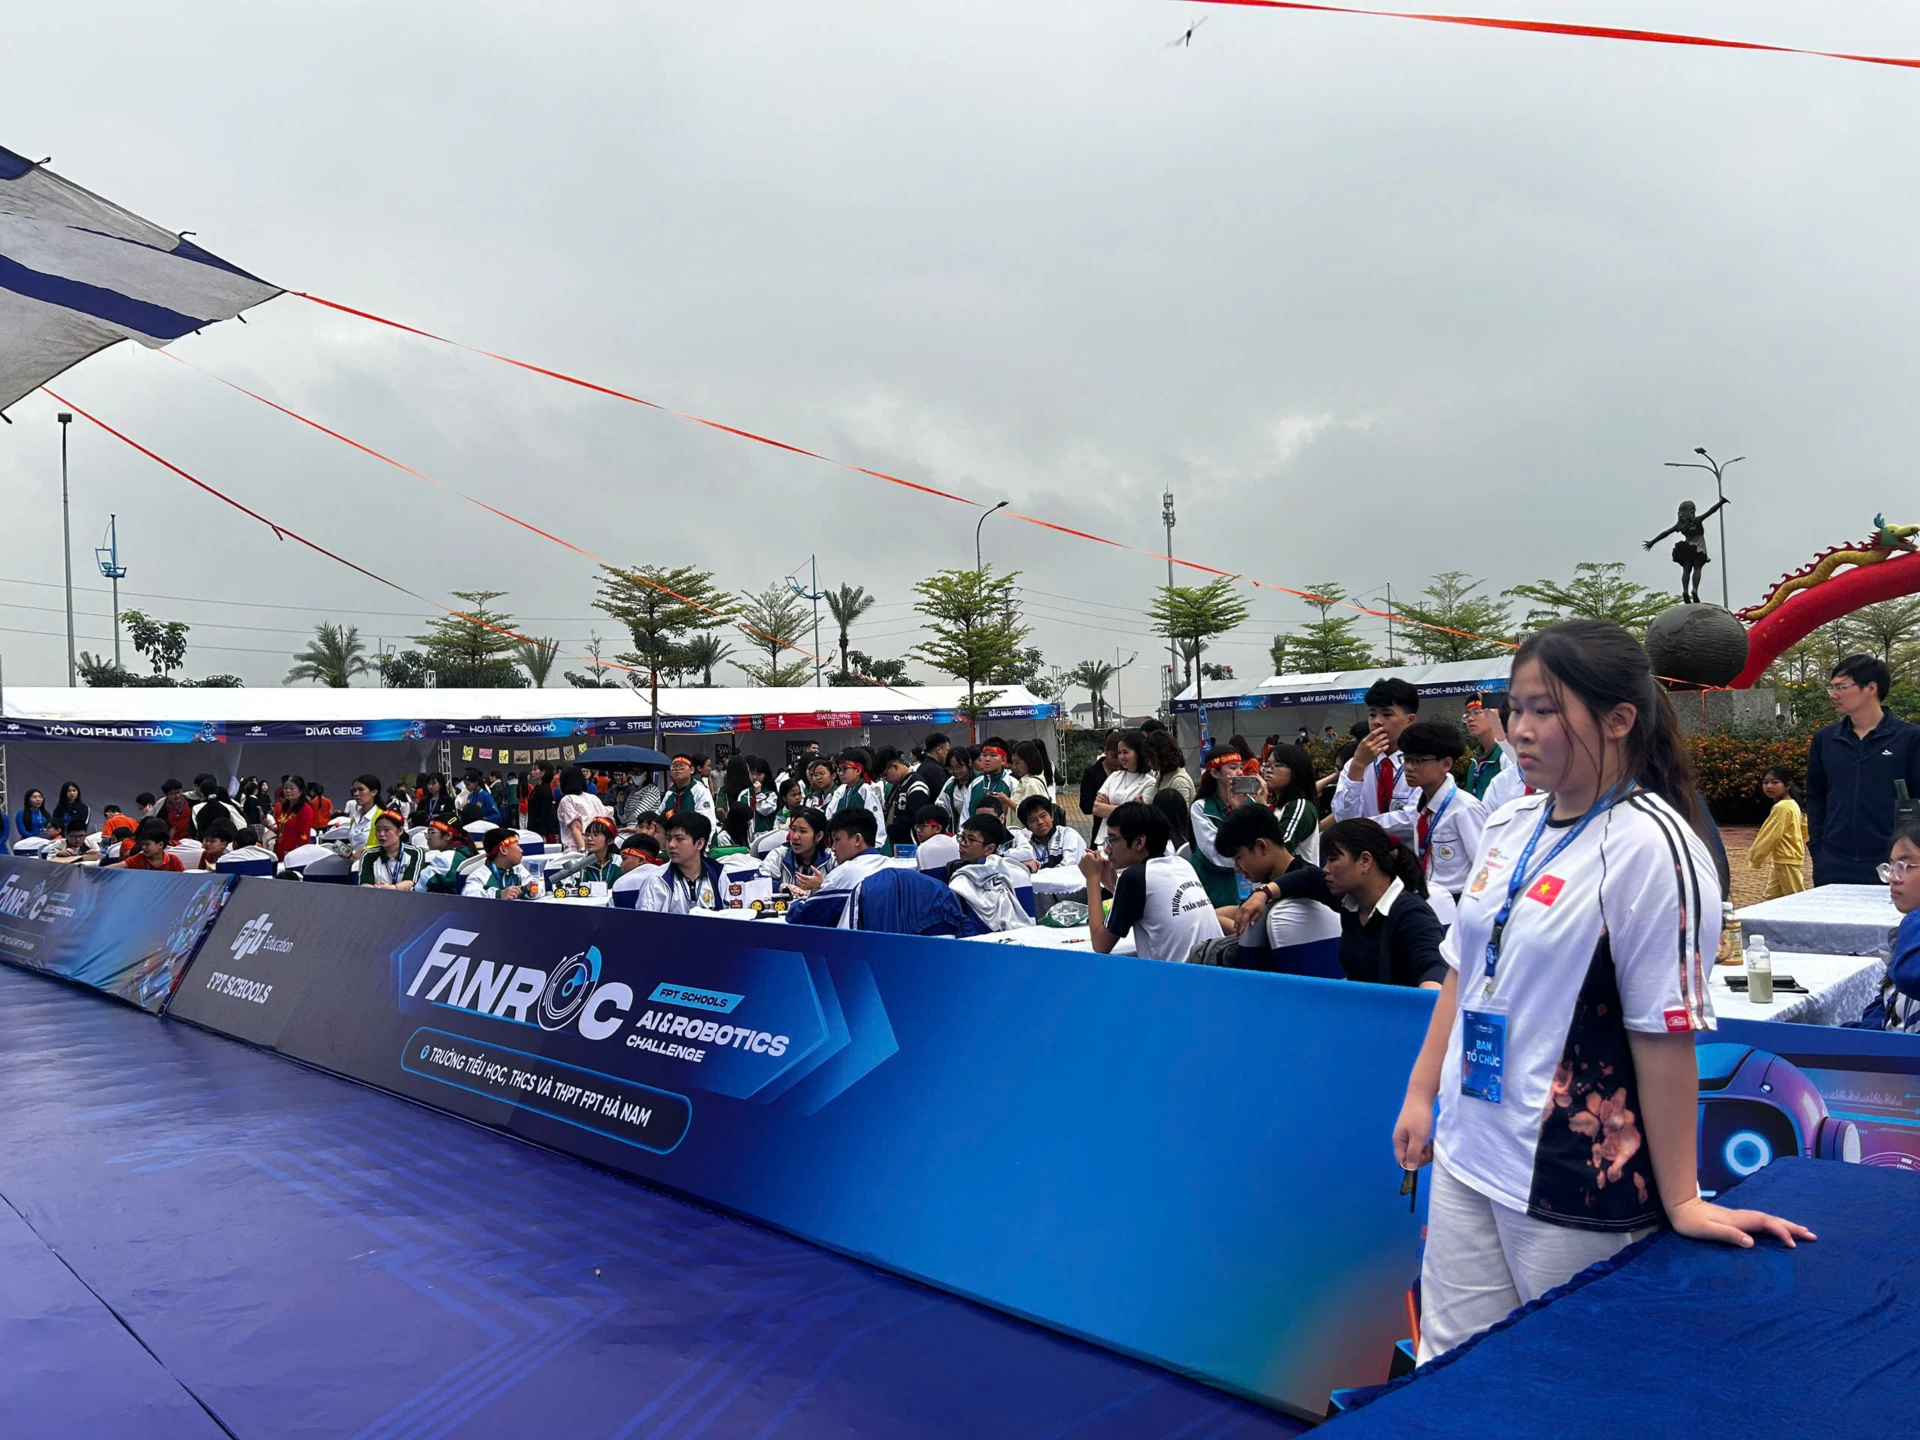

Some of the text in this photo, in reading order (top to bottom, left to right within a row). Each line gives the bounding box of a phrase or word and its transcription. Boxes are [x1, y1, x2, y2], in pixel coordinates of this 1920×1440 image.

[70, 727, 94, 737] VOI
[96, 727, 133, 737] PHUN
[135, 725, 173, 737] TRÀO
[305, 726, 363, 736] DIVA GENZ
[660, 720, 701, 729] WORKOUT
[230, 913, 294, 960] FPT Education
[207, 971, 273, 1004] FPT SCHOOLS
[406, 927, 634, 1041] FANROC
[659, 988, 728, 1008] FPT SCHOOLS
[636, 1009, 790, 1057] AI&ROBOTICS
[626, 1034, 705, 1063] CHALLENGE
[1475, 1040, 1492, 1051] BAN
[1466, 1049, 1501, 1067] TỔ CHỨC
[429, 1047, 652, 1127] TRƯỜNG TIỂU HỌC, THCS VÀ THPT FPT HÀ NAM
